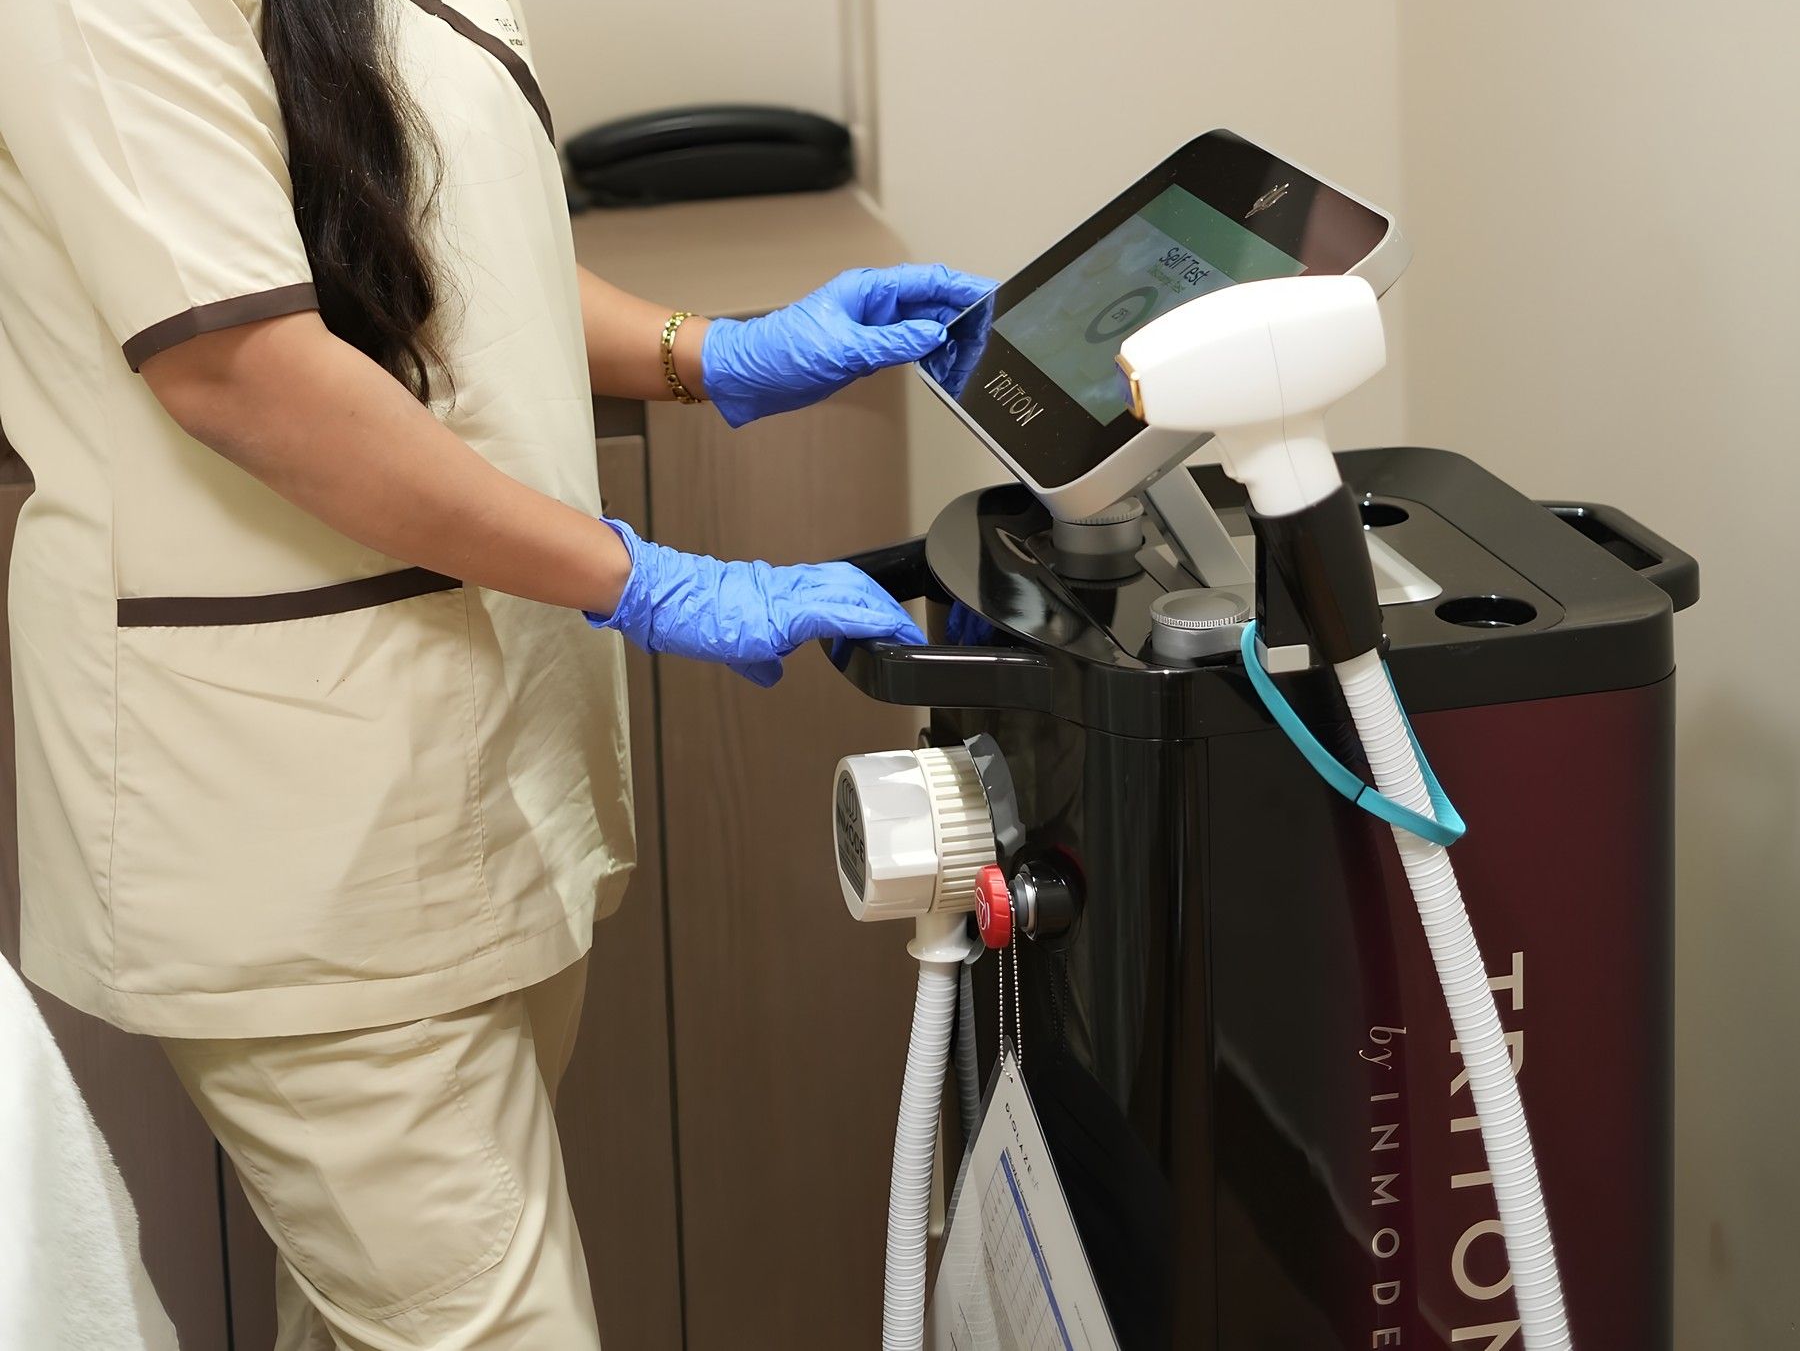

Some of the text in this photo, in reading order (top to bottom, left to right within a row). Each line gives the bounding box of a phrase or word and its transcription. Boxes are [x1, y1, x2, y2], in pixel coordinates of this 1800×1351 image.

[1159, 247, 1192, 270] Self
[1179, 259, 1210, 286] Test
[984, 370, 1044, 427] TRITON
[1359, 1026, 1407, 1350] by INMODE
